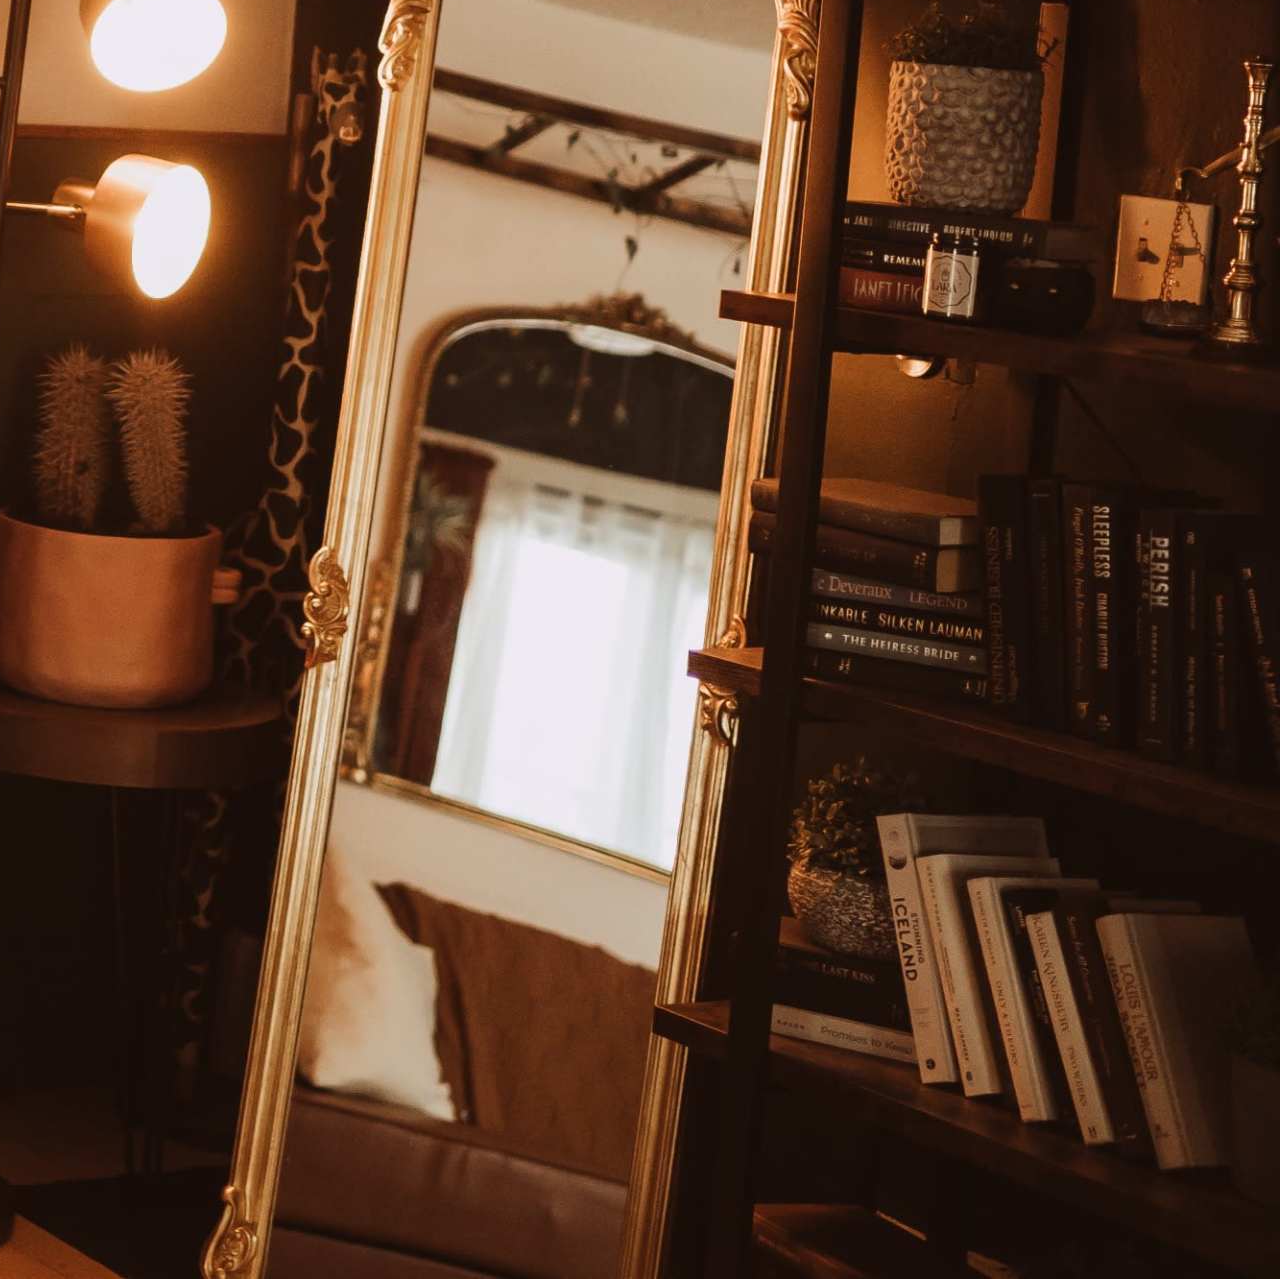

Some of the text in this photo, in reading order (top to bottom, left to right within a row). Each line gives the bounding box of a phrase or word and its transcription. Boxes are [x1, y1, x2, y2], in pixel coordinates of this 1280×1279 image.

[1092, 505, 1111, 578] SLEEPLESS
[1150, 536, 1170, 607] PERISH
[840, 633, 960, 661] THE HEIRESS BRIDE
[878, 612, 925, 633] SILKEN
[929, 620, 984, 641] LAUMAN
[892, 896, 918, 982] ICELAND
[1119, 962, 1141, 1009] LOUIS
